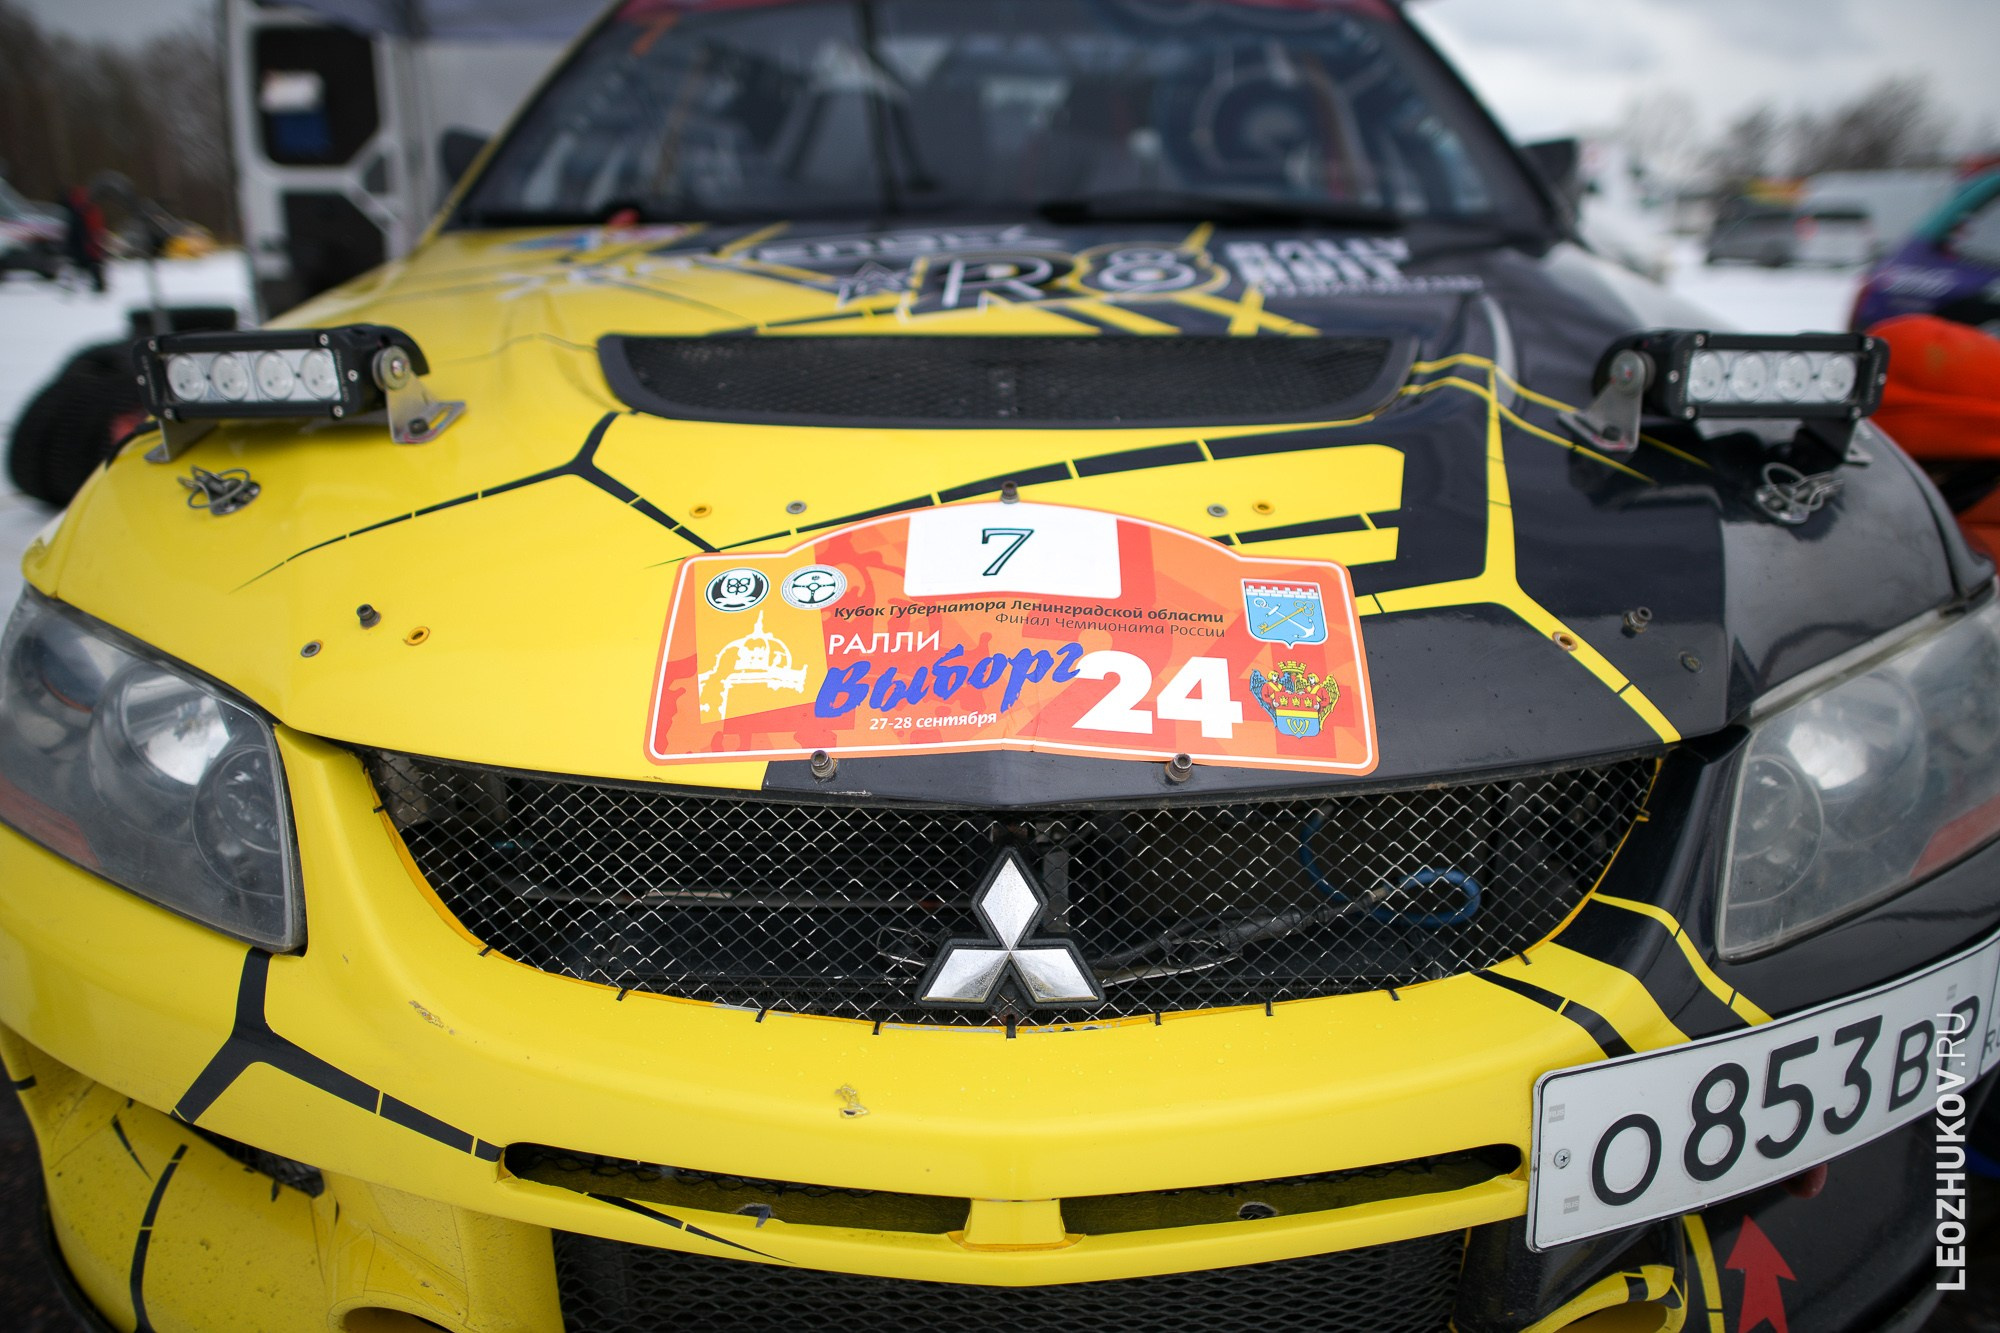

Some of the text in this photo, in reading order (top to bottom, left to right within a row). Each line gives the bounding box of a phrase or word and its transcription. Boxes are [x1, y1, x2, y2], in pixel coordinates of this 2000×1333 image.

[981, 528, 1035, 576] 7
[834, 600, 1224, 624] Кубок Губернатора Ленинградской области
[995, 613, 1225, 638] Финал Чемпионата России
[828, 630, 940, 655] РАЛЛИ
[814, 642, 1084, 719] Выборг
[1071, 651, 1243, 739] 24
[869, 711, 997, 731] 27-28 сентября
